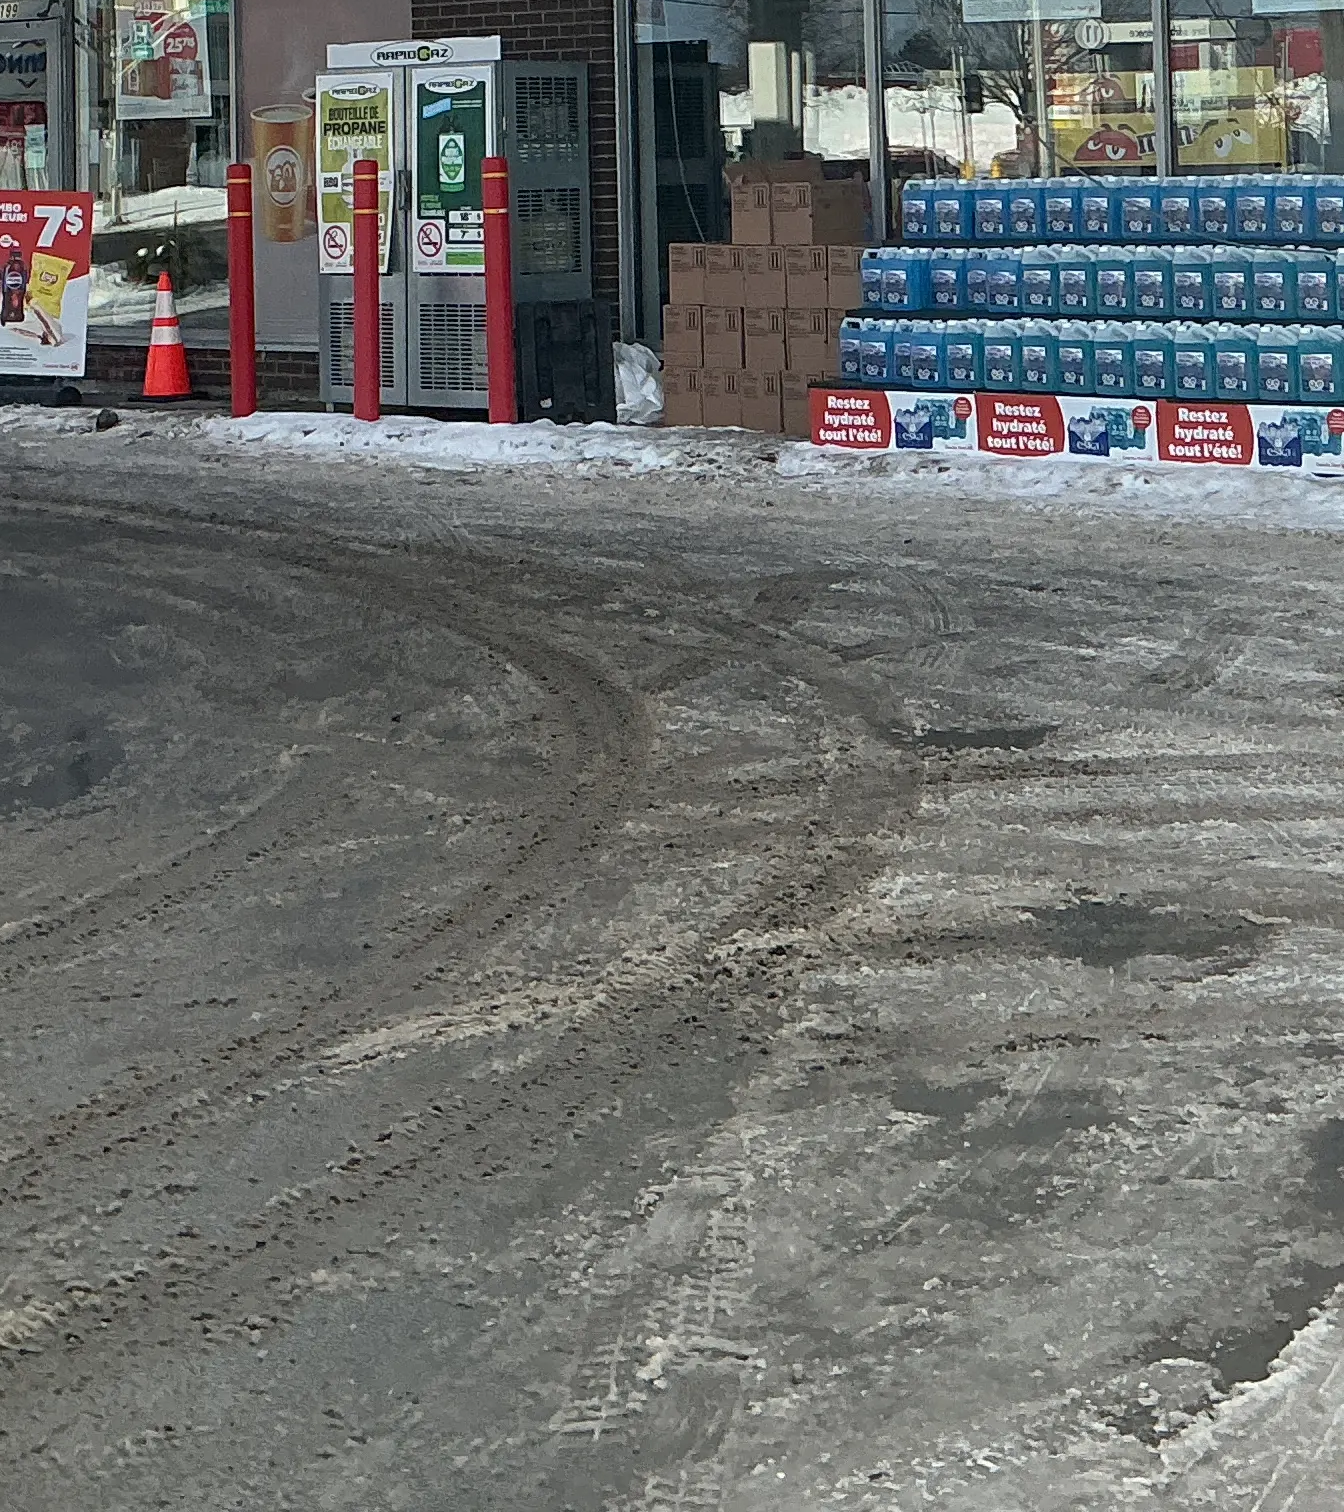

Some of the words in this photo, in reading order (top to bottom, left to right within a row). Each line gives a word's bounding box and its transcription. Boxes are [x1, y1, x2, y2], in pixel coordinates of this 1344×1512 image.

[328, 106, 368, 121] BOUTEILLE
[369, 105, 379, 120] DE
[323, 120, 386, 136] PROPANE
[33, 205, 84, 248] 7$
[827, 396, 871, 410] Restez
[994, 402, 1042, 417] Restez
[824, 411, 875, 427] hydraté
[1177, 407, 1228, 423] Restez
[992, 417, 1047, 435] hydraté
[1174, 423, 1234, 442] hydraté
[819, 427, 847, 442] tout
[848, 427, 882, 443] l'été!
[987, 435, 1018, 449] tout
[1018, 435, 1055, 452] l'été!
[1168, 442, 1202, 457] tout
[1202, 442, 1243, 459] l'été!
